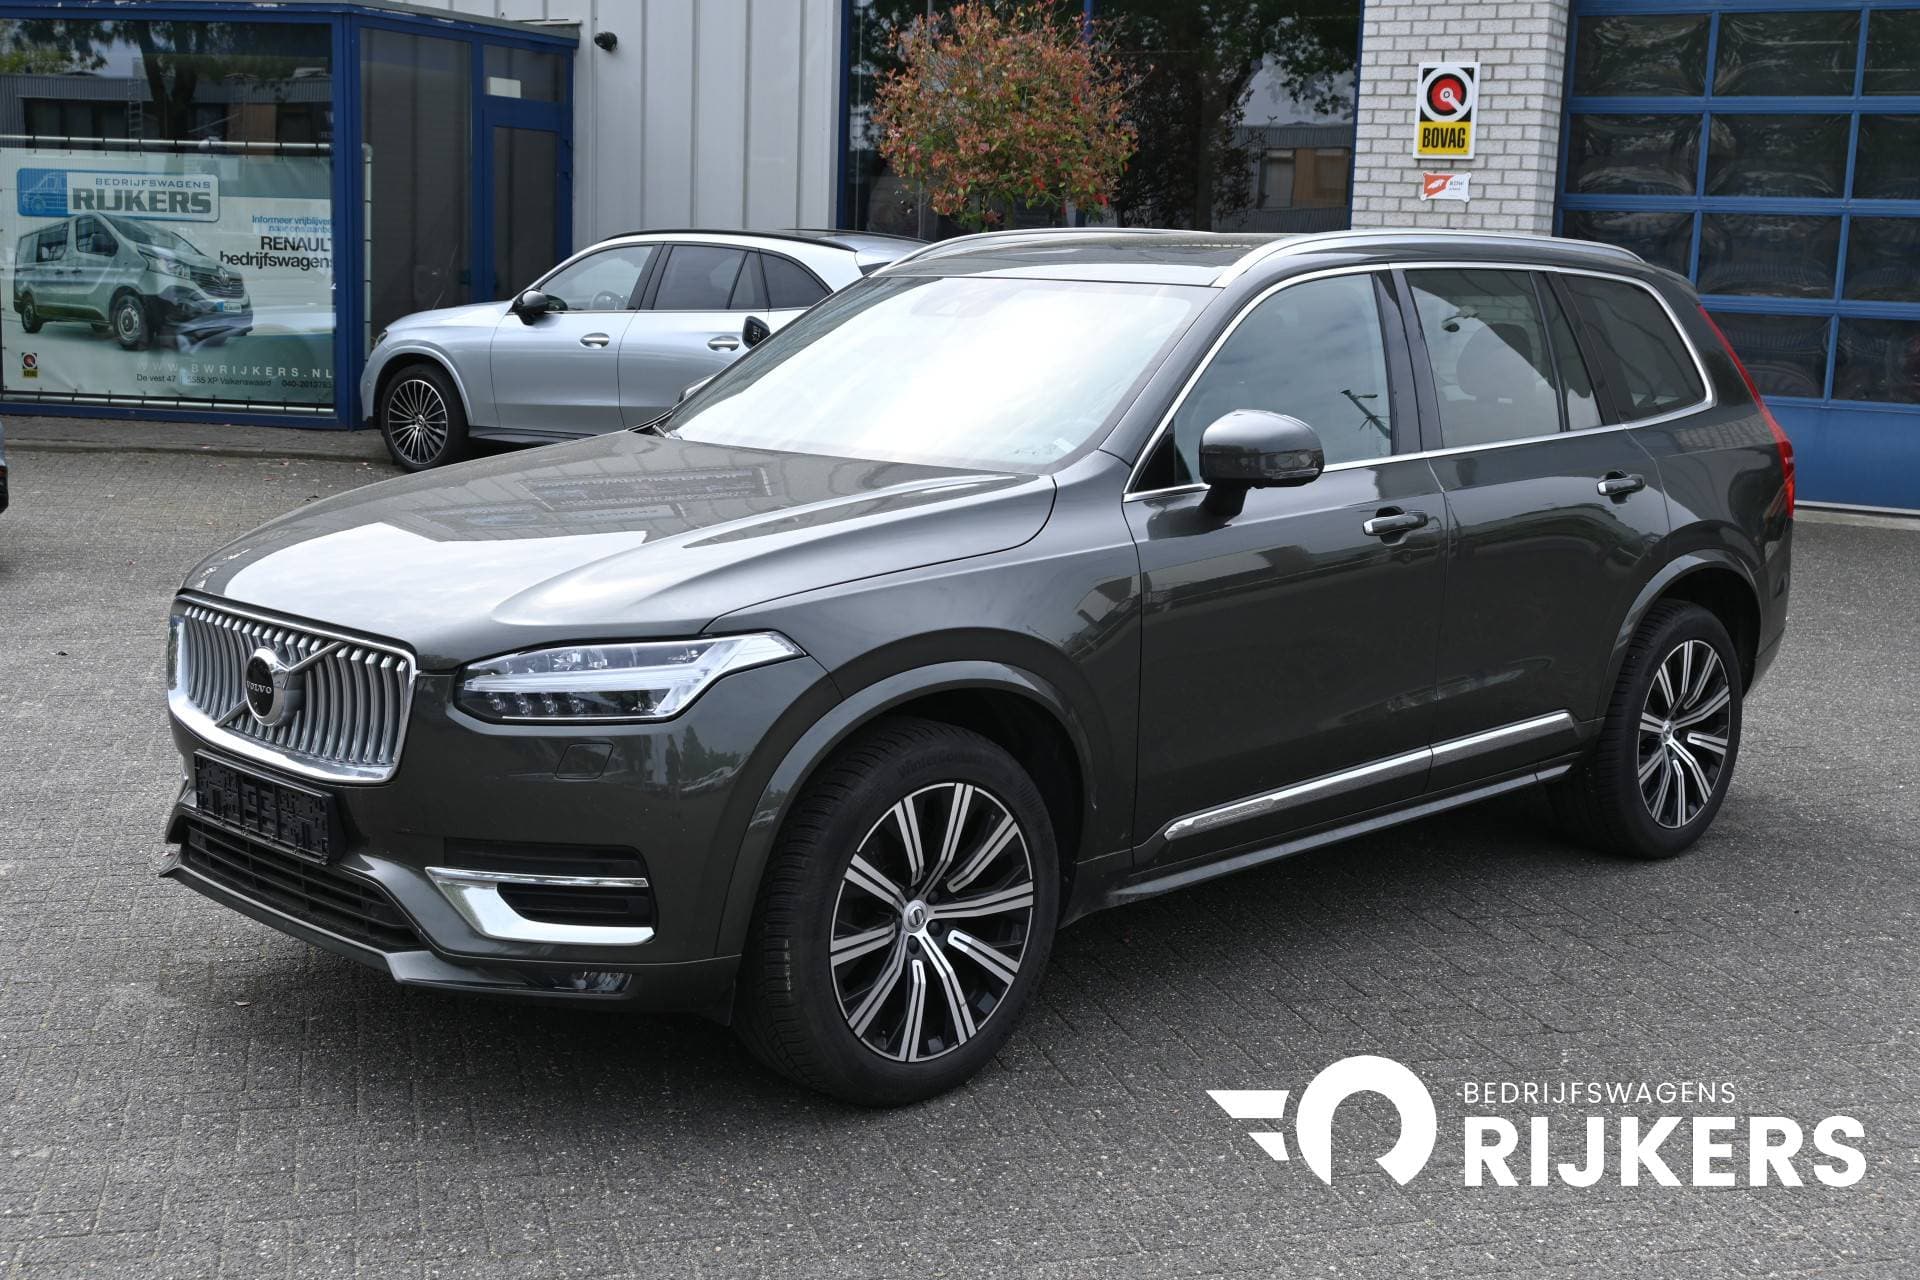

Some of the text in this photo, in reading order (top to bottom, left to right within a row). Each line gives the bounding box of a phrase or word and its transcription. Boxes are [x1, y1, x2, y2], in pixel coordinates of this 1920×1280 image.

[1422, 127, 1466, 149] BOVAG
[95, 177, 211, 189] BEDRIJFSWAGENS
[72, 188, 212, 214] RIJKERS
[252, 215, 293, 225] Informeer
[136, 373, 148, 382] De
[207, 376, 218, 385] XP
[246, 680, 273, 695] VOLVO
